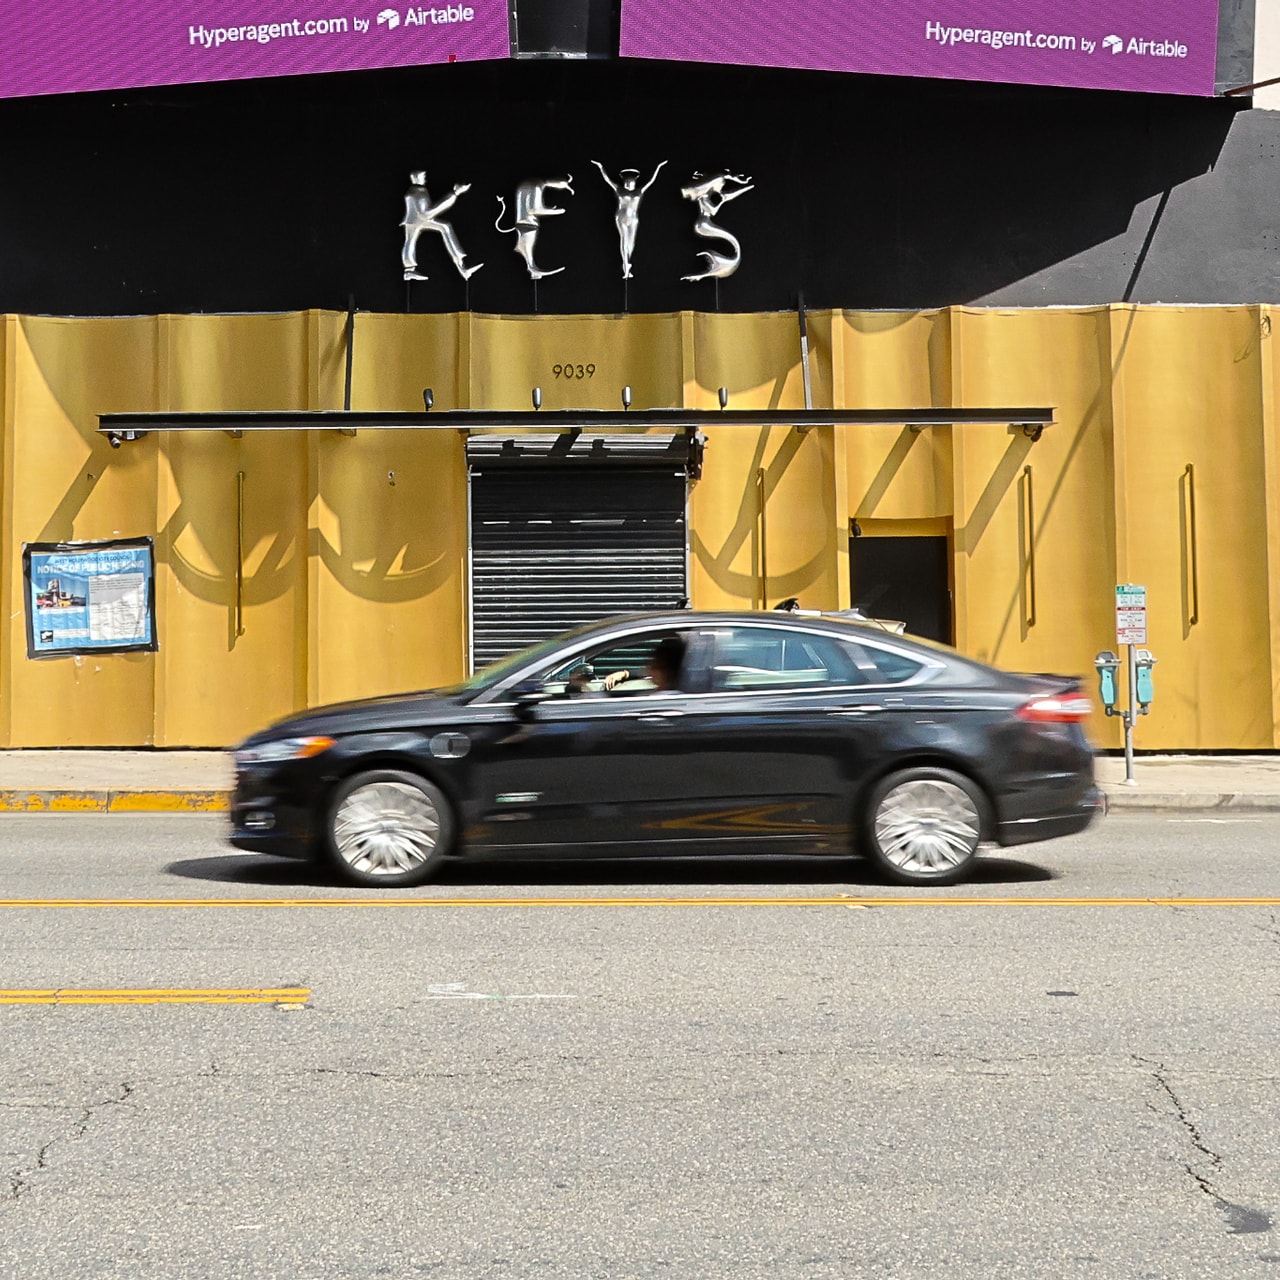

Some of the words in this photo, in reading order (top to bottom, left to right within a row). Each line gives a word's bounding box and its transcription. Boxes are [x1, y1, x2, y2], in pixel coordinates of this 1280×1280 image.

[189, 17, 348, 49] Hyperagent.com
[353, 16, 370, 34] by
[404, 3, 475, 27] Airtable
[925, 20, 1076, 51] Hyperagent.com
[1080, 37, 1097, 54] by
[1126, 37, 1188, 58] Airtable
[551, 363, 597, 380] 9039
